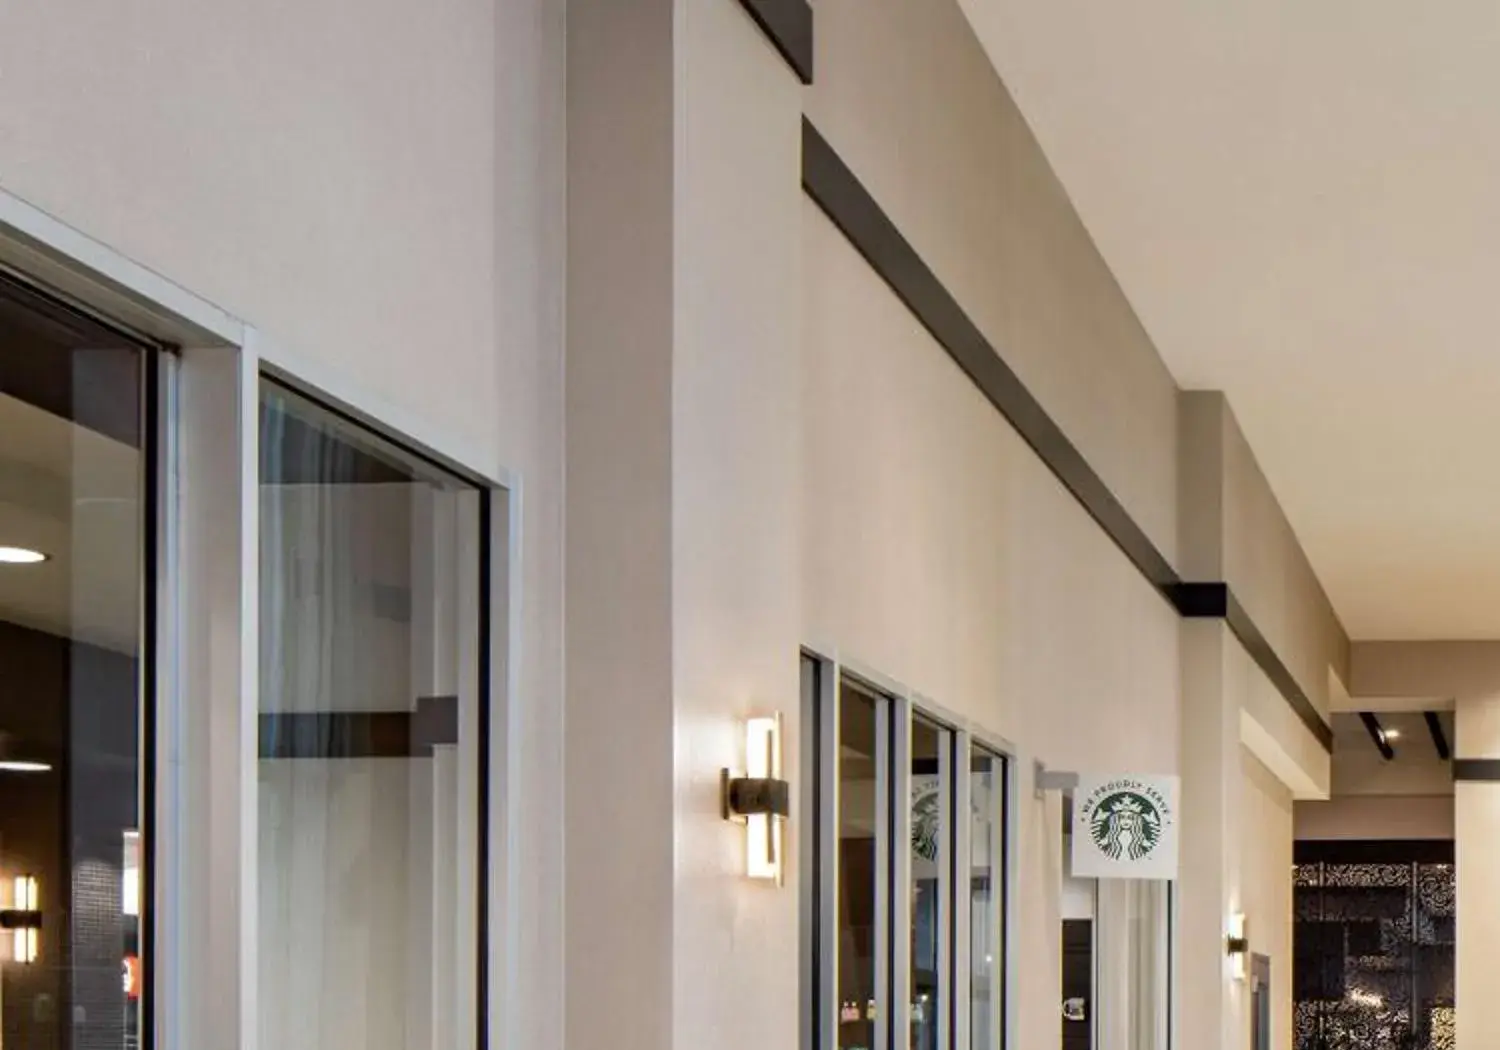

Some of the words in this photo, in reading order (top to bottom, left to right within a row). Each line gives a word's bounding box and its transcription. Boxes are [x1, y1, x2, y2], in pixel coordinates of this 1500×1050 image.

[1083, 798, 1094, 813] WE
[1094, 780, 1142, 797] PROUDLY
[1145, 786, 1169, 814] SERVE
